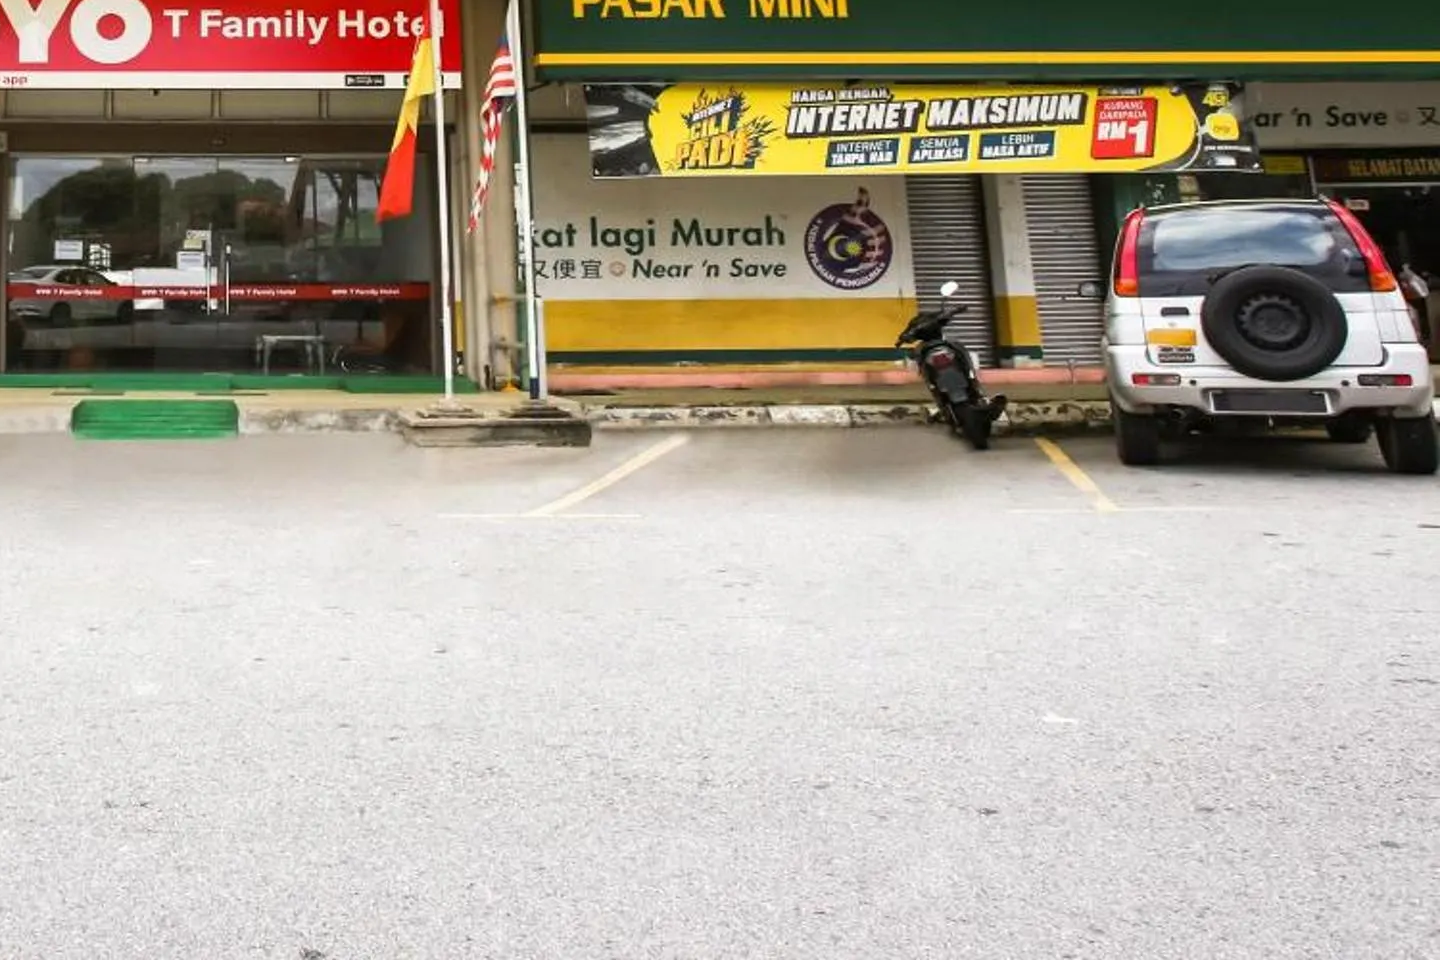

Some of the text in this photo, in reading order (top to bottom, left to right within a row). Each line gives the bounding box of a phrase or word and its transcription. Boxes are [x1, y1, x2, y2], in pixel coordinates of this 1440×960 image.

[163, 9, 188, 38] T
[200, 9, 328, 44] Family
[2, 76, 27, 86] app
[787, 94, 1082, 134] INTERNET MAKSIMUM
[1254, 110, 1282, 127] ar
[1326, 106, 1388, 127] Save
[836, 140, 892, 152] INTERNET
[919, 138, 959, 149] SEMUA
[1002, 134, 1034, 145] LEBIH
[912, 148, 963, 161] APLIKASI
[591, 217, 655, 255] lagi
[671, 215, 786, 247] Murah
[632, 260, 692, 278] Near
[730, 258, 787, 278] Save
